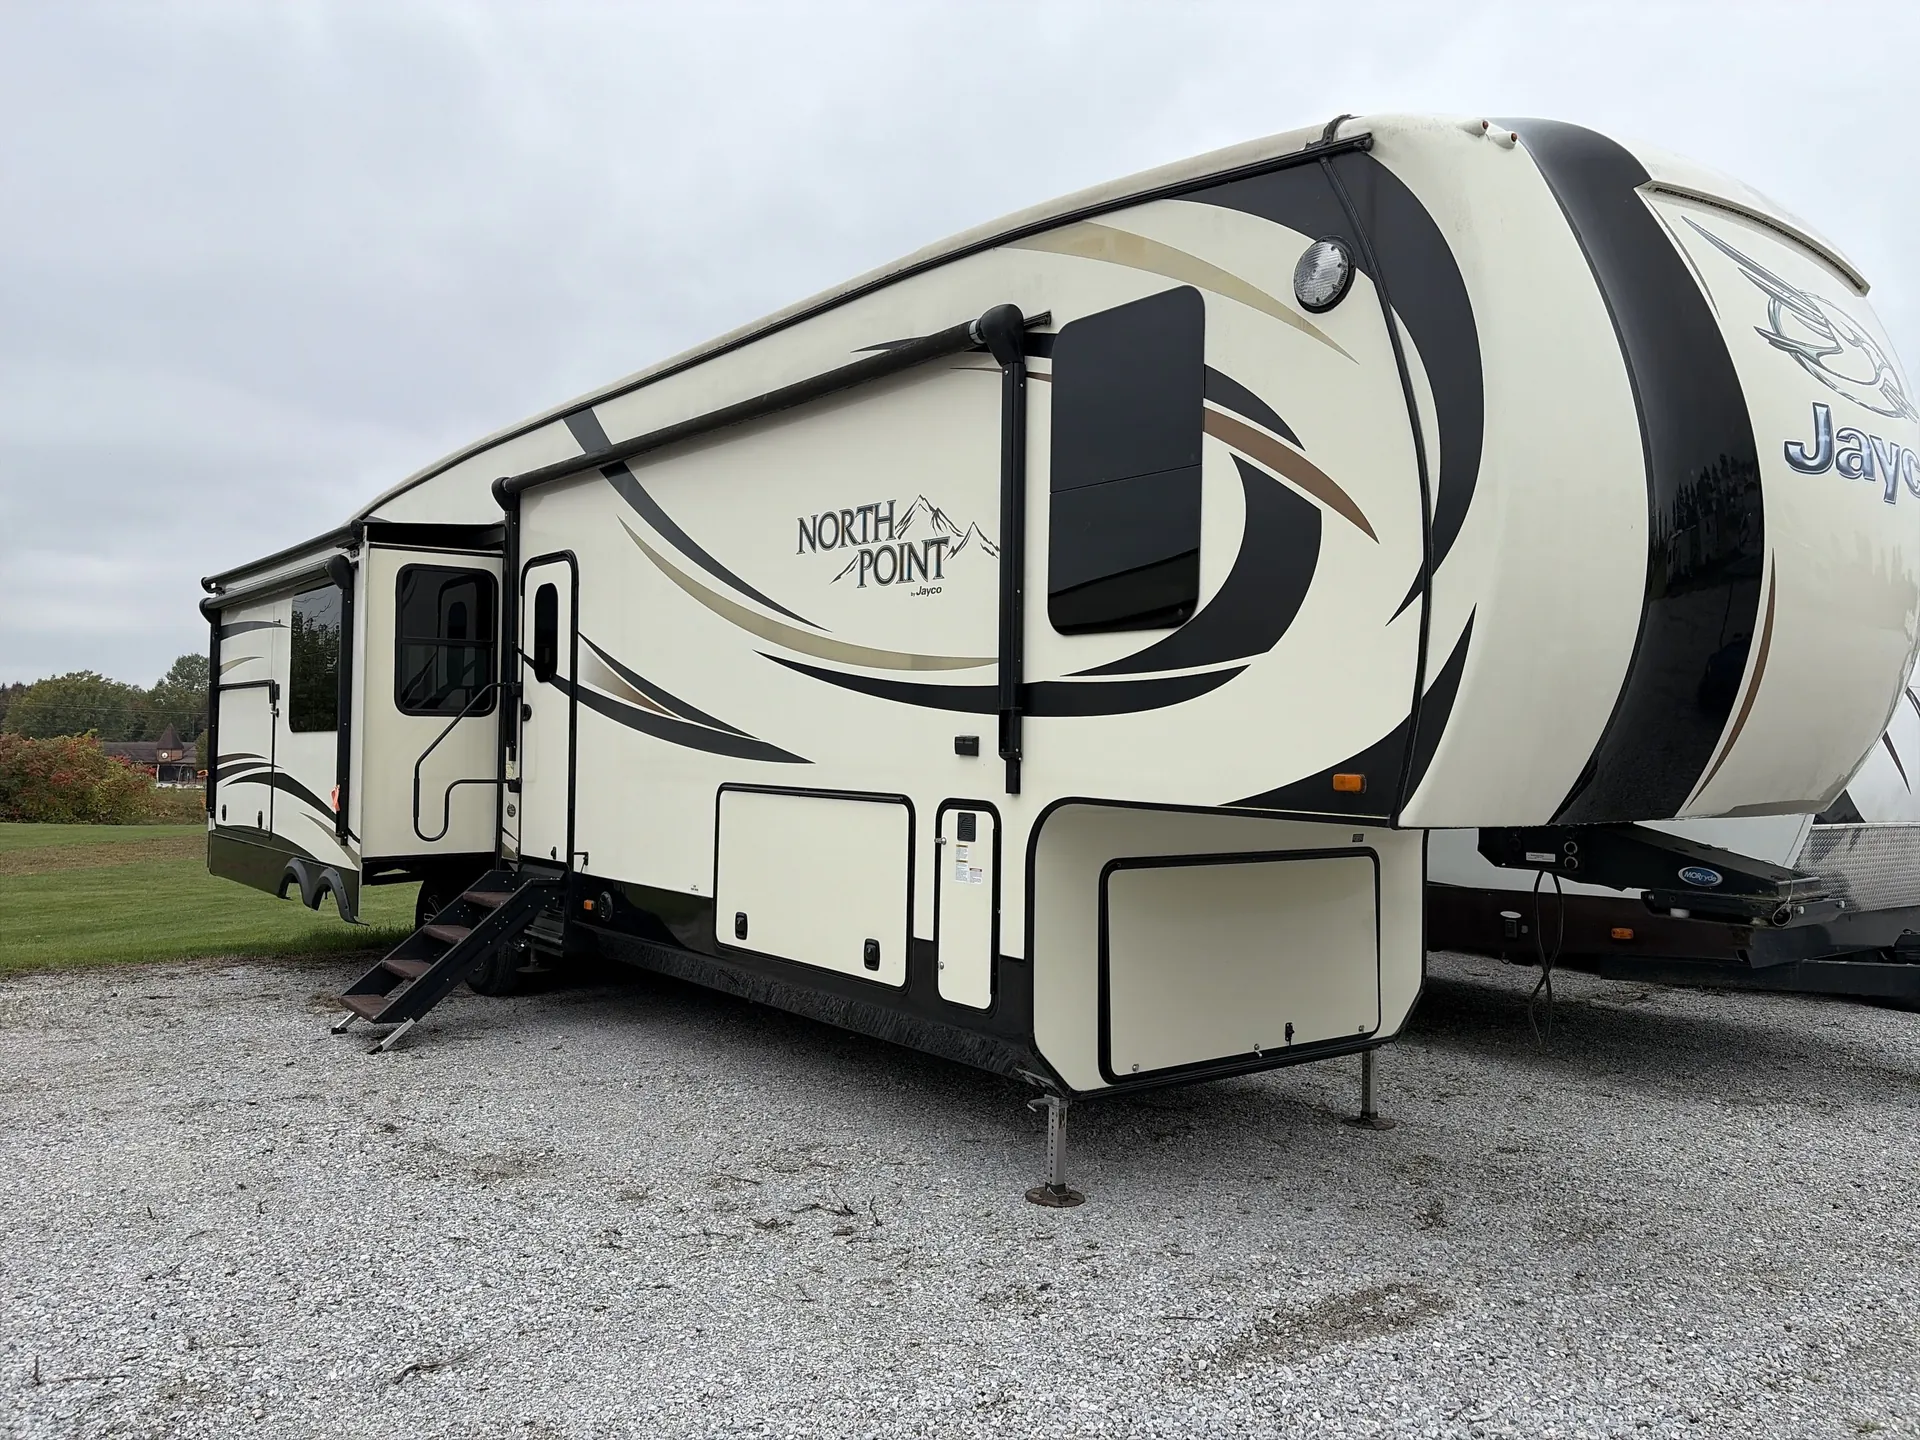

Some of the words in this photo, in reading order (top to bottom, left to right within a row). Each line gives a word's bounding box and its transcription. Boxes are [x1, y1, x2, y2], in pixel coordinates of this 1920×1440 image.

[796, 499, 896, 554] NORTH
[857, 536, 949, 588] POINT
[916, 585, 942, 597] Jayco
